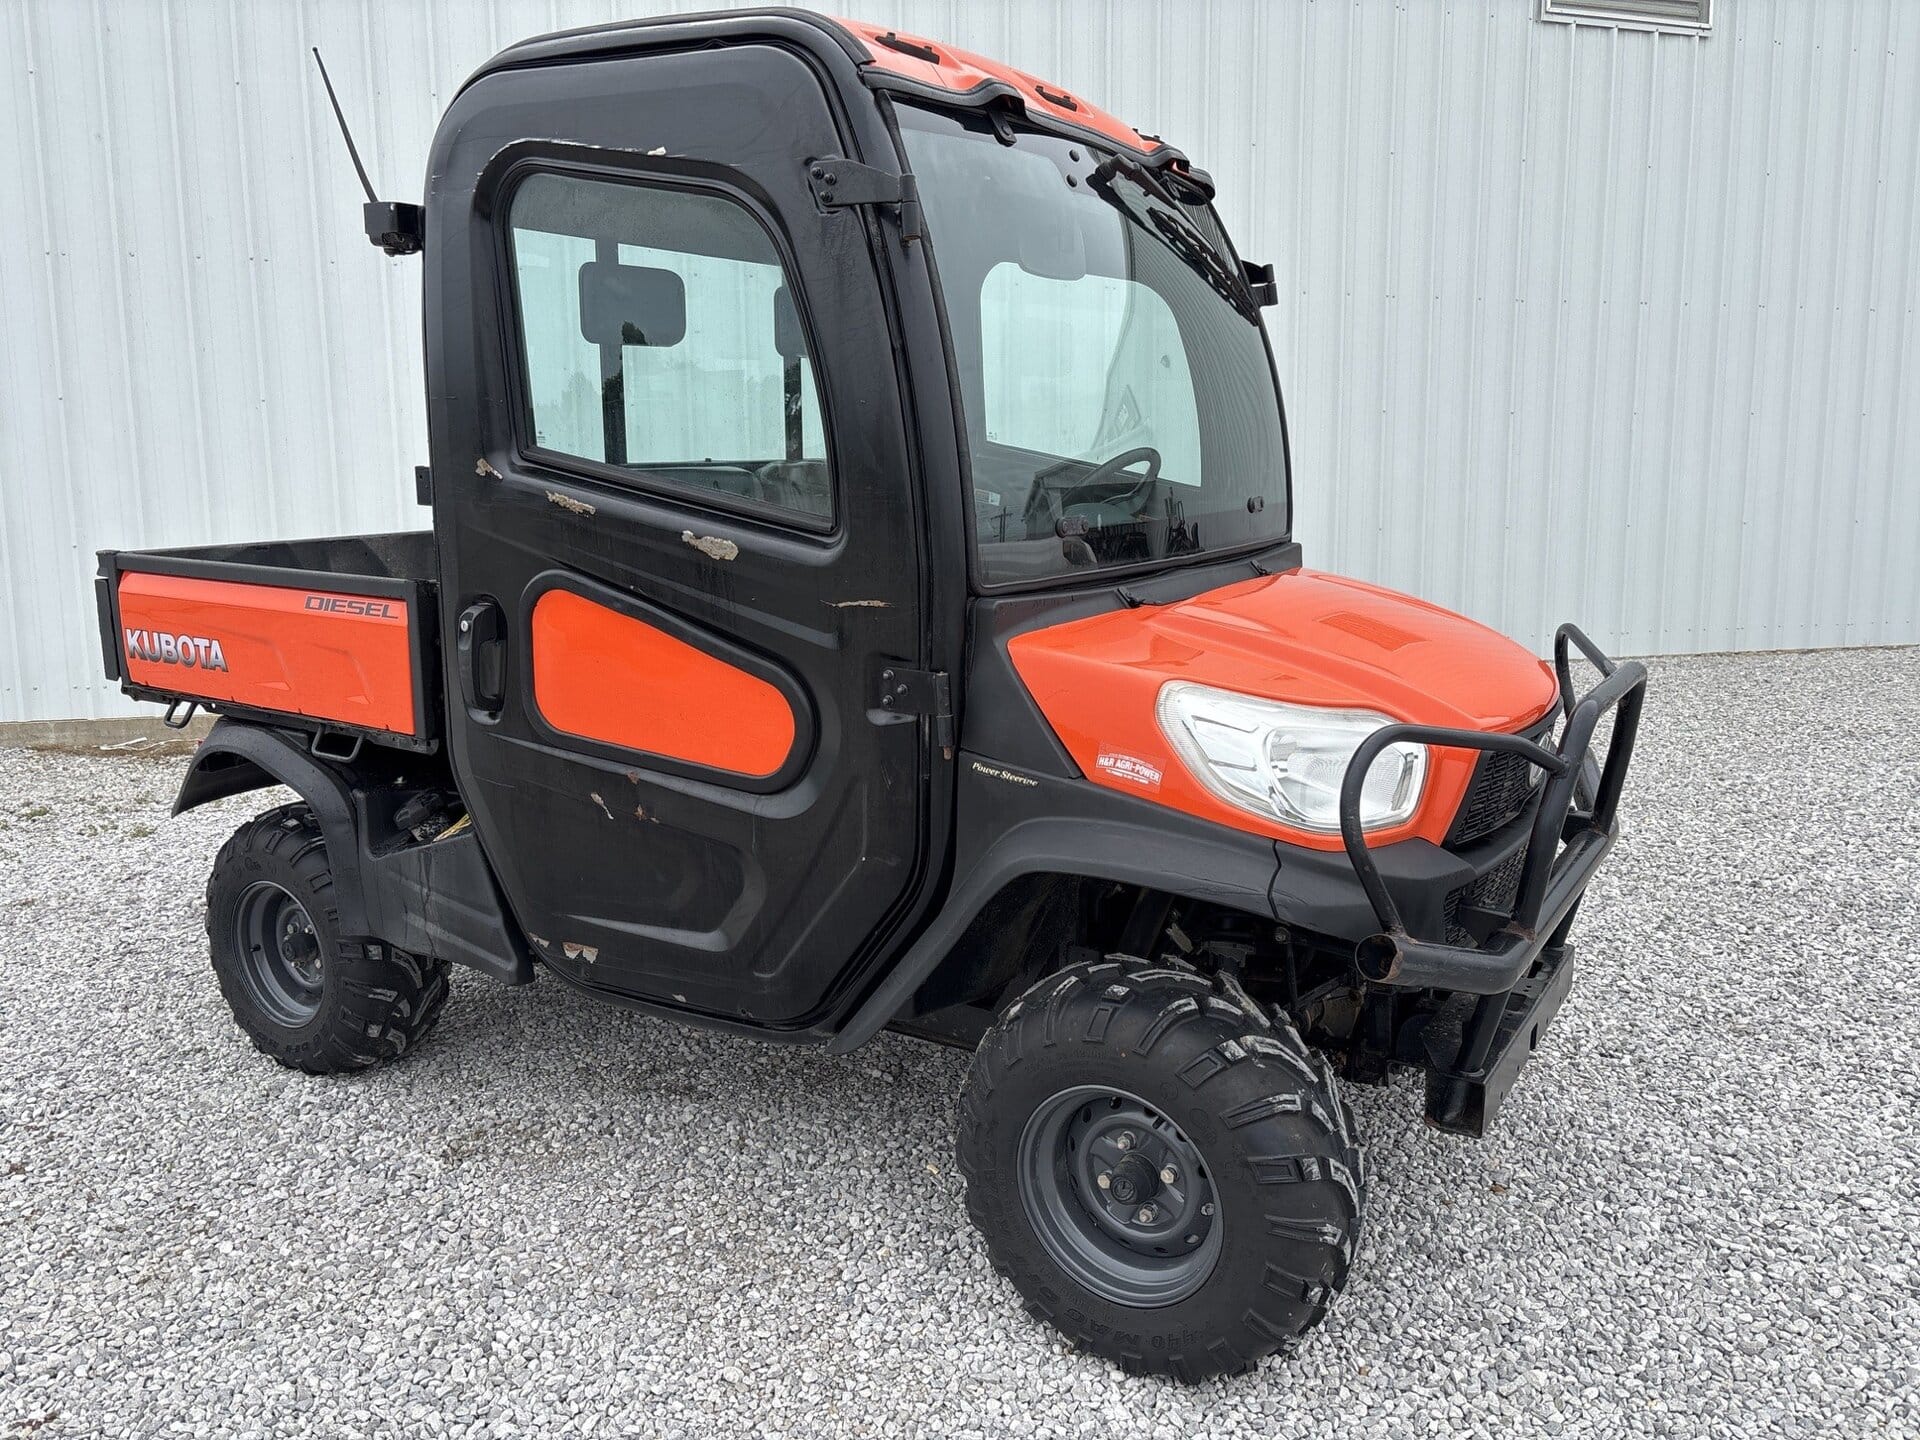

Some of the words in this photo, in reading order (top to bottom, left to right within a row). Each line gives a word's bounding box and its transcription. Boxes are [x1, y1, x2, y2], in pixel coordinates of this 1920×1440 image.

[303, 595, 399, 619] DIESEL
[125, 628, 228, 672] KUBOTA
[972, 761, 1000, 777] Power
[1098, 756, 1115, 767] H&R
[1115, 759, 1160, 782] AGRI-POWER
